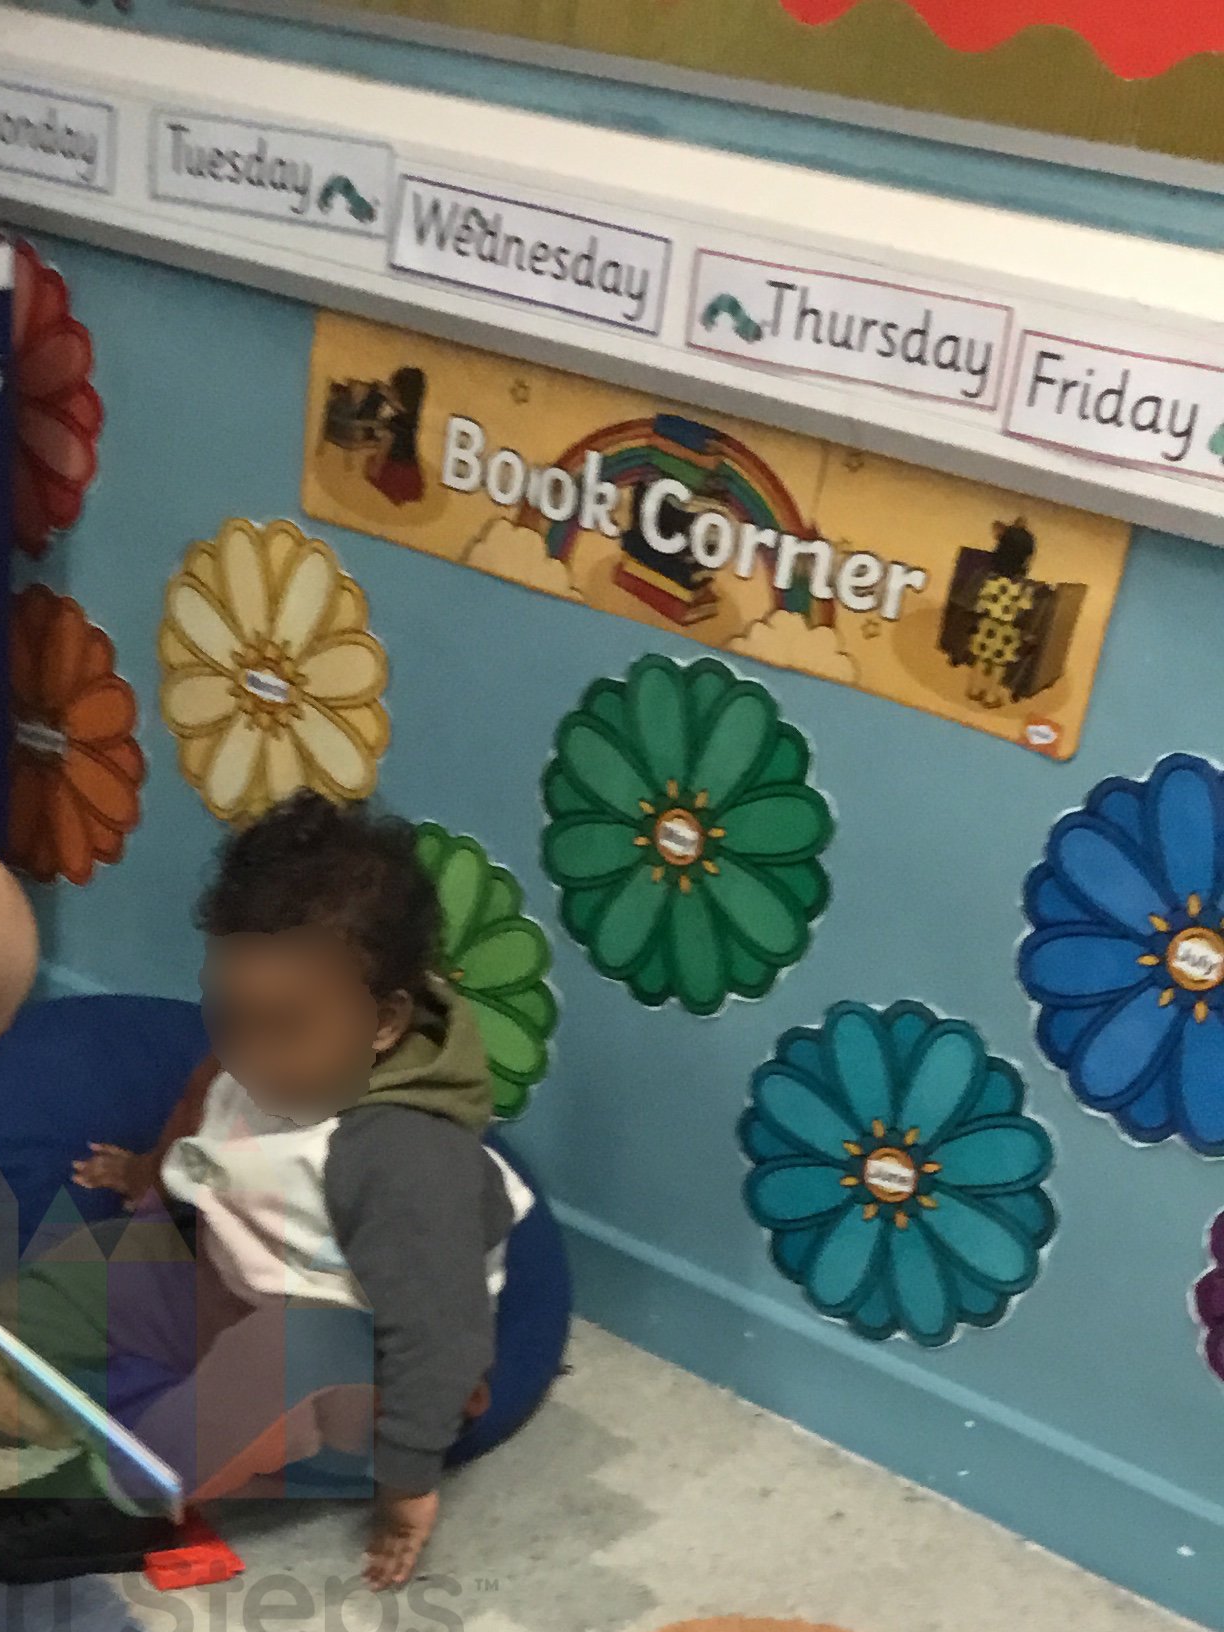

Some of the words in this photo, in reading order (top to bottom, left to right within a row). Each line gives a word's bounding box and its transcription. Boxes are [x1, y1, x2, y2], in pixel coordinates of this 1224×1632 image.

[167, 124, 313, 214] Tuesday
[412, 193, 651, 322] Wednesday
[767, 280, 994, 398] Thursday
[1025, 350, 1200, 462] Friday
[440, 413, 622, 538] Book
[640, 477, 926, 621] Corner
